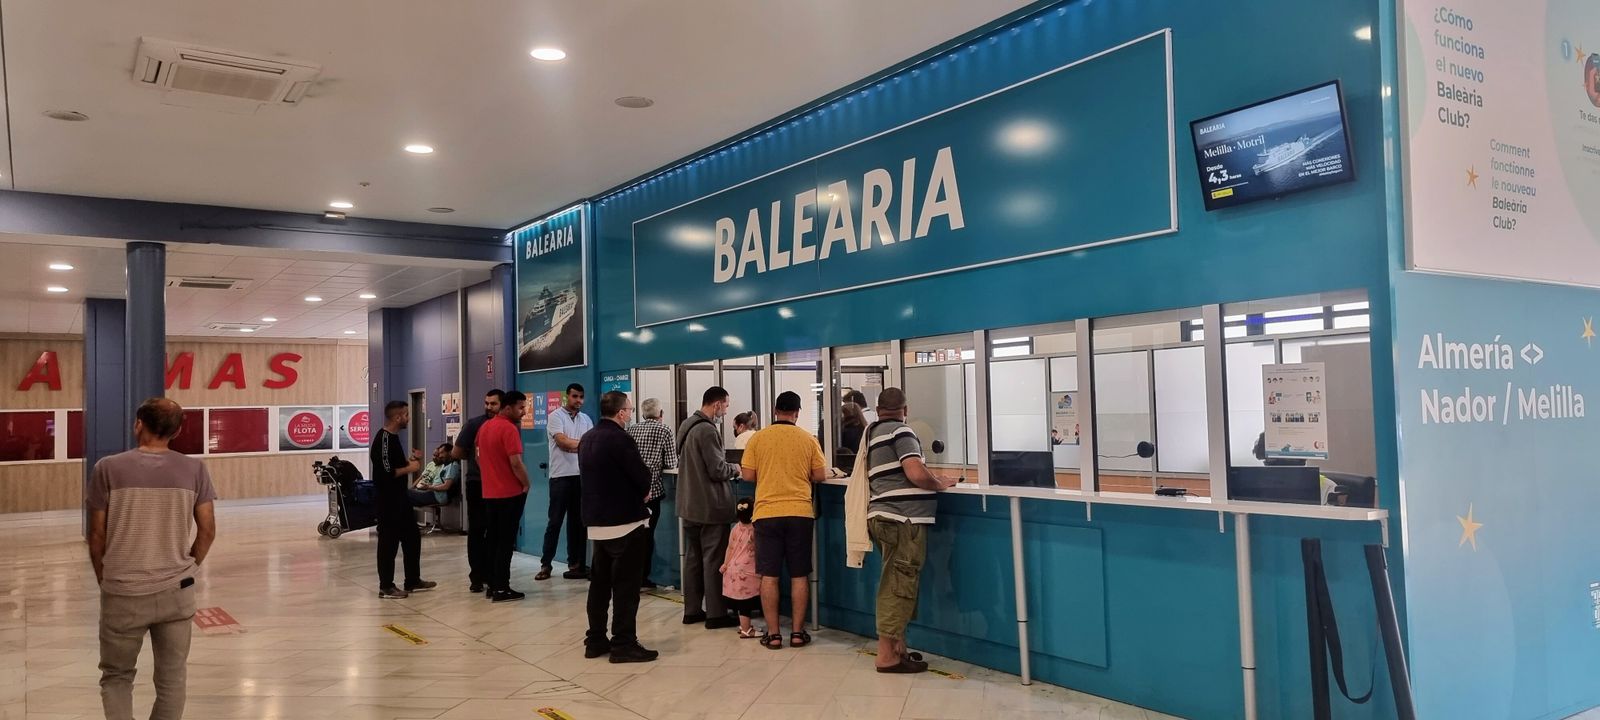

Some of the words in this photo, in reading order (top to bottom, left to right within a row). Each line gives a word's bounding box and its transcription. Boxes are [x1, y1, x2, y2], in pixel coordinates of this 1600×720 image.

[1434, 7, 1473, 32] ¿Cómo
[1434, 30, 1485, 59] funciona
[1435, 57, 1447, 71] el
[1449, 61, 1484, 83] nuevo
[1437, 81, 1483, 108] Baleària
[1438, 107, 1470, 128] Club?
[1203, 144, 1233, 159] Melilla
[1236, 134, 1265, 152] Motril
[1490, 138, 1530, 159] Comment
[1206, 163, 1223, 172] Desde
[1315, 159, 1342, 168] VELOCIDAD
[1490, 158, 1535, 178] fonctionne
[1208, 169, 1229, 185] 4,3
[1492, 177, 1500, 190] le
[1500, 178, 1537, 196] nouveau
[1492, 215, 1517, 230] Club?
[1418, 333, 1514, 370] Almería
[536, 396, 544, 407] TV
[1420, 388, 1496, 425] Nador
[1518, 384, 1585, 420] Melilla
